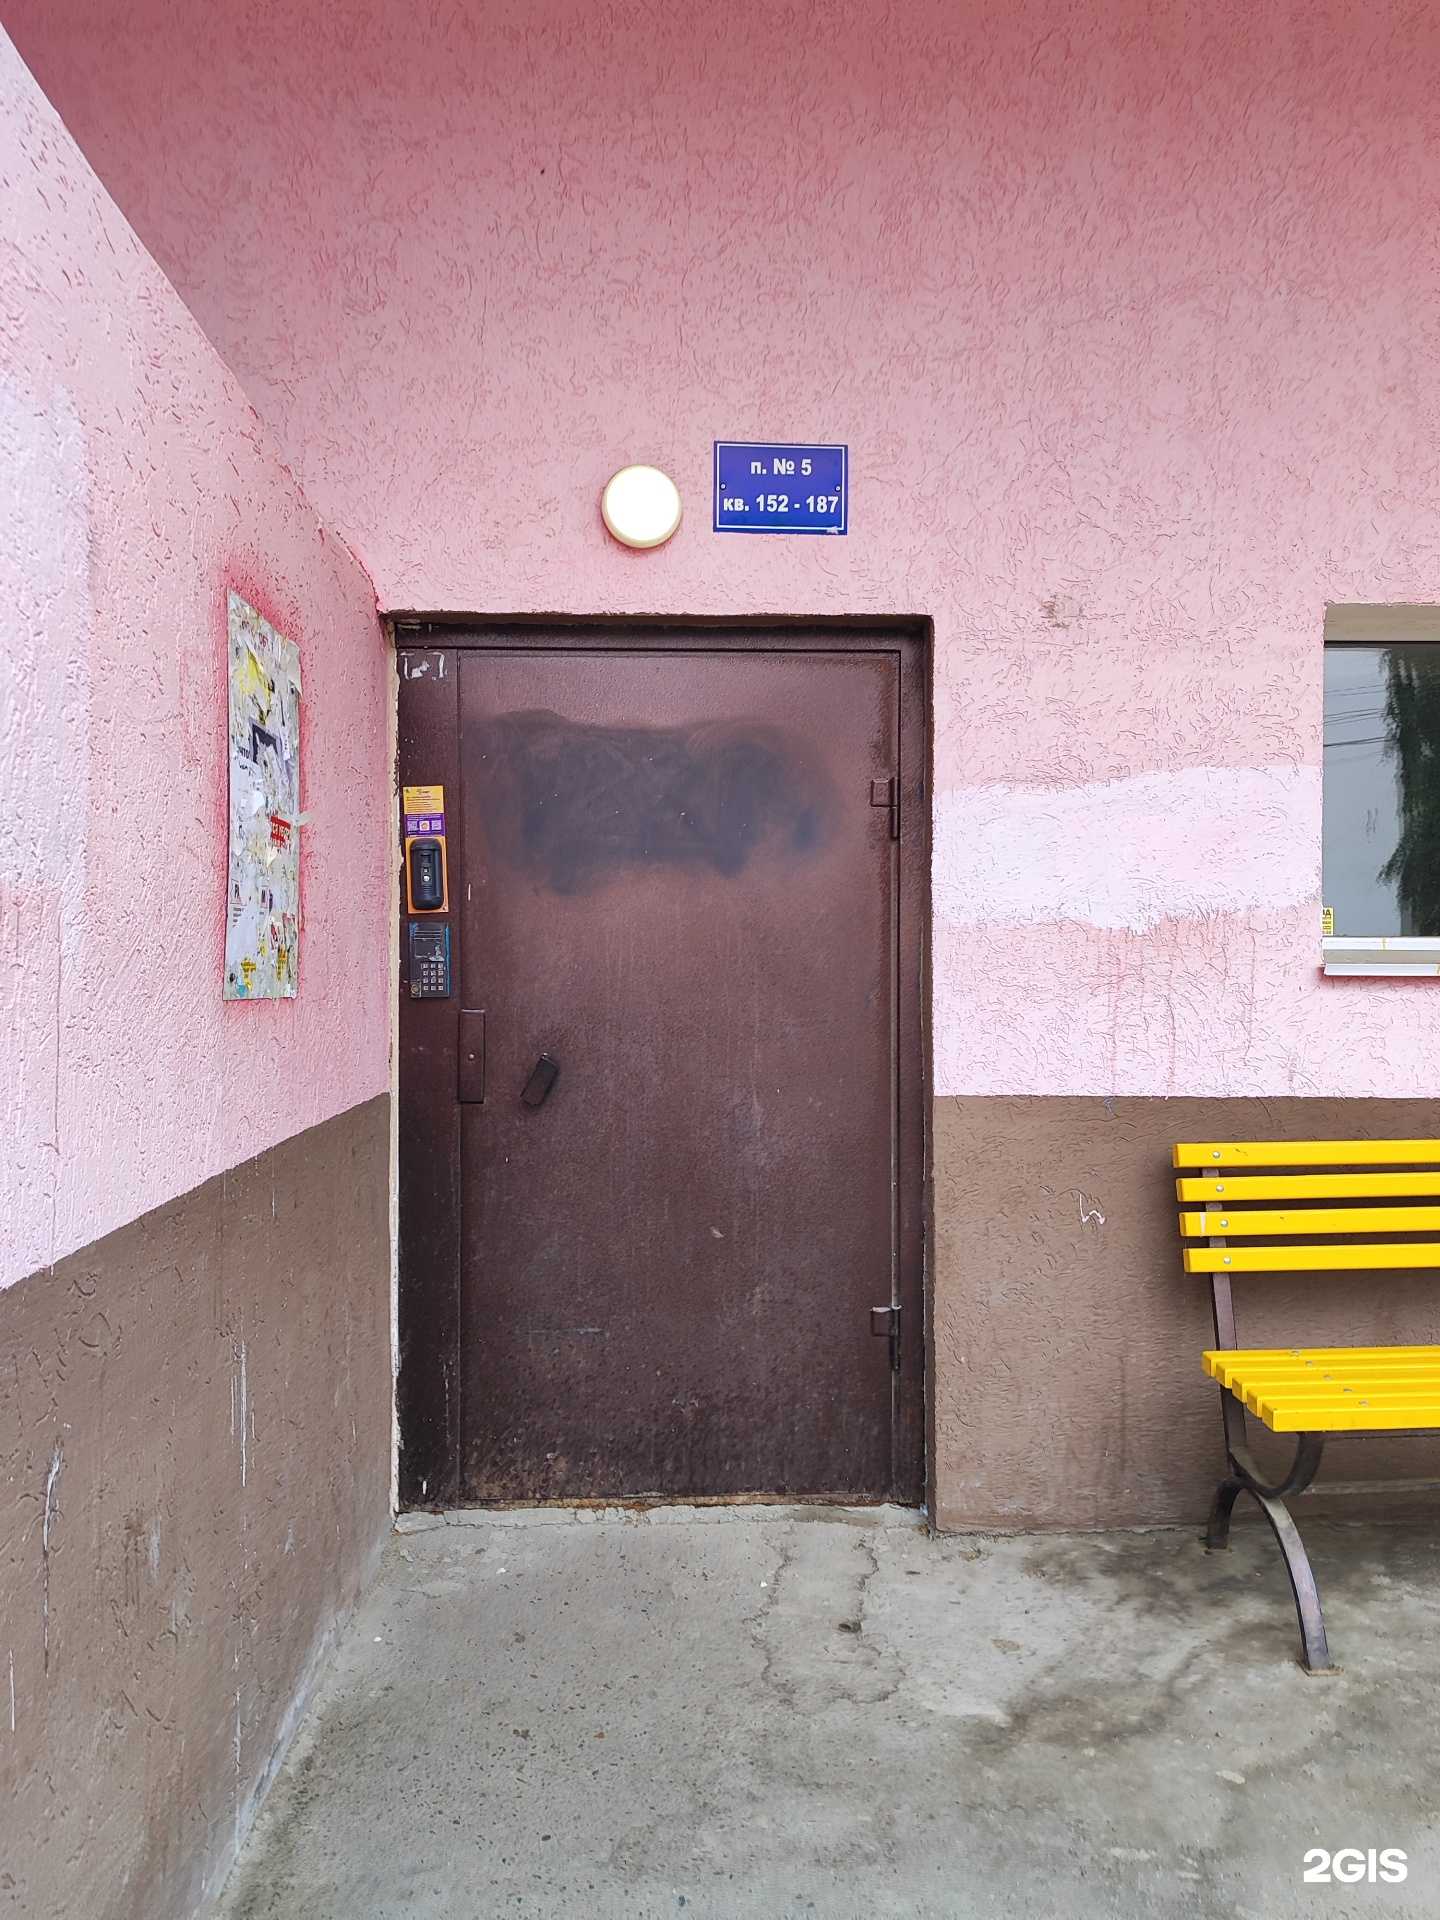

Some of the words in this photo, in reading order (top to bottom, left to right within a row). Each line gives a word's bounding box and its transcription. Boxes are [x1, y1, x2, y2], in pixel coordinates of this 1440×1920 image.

[750, 461, 767, 475] п.
[773, 458, 795, 475] №
[801, 458, 812, 476] 5
[723, 498, 750, 512] кв.
[755, 494, 789, 512] 152
[805, 495, 839, 513] 187
